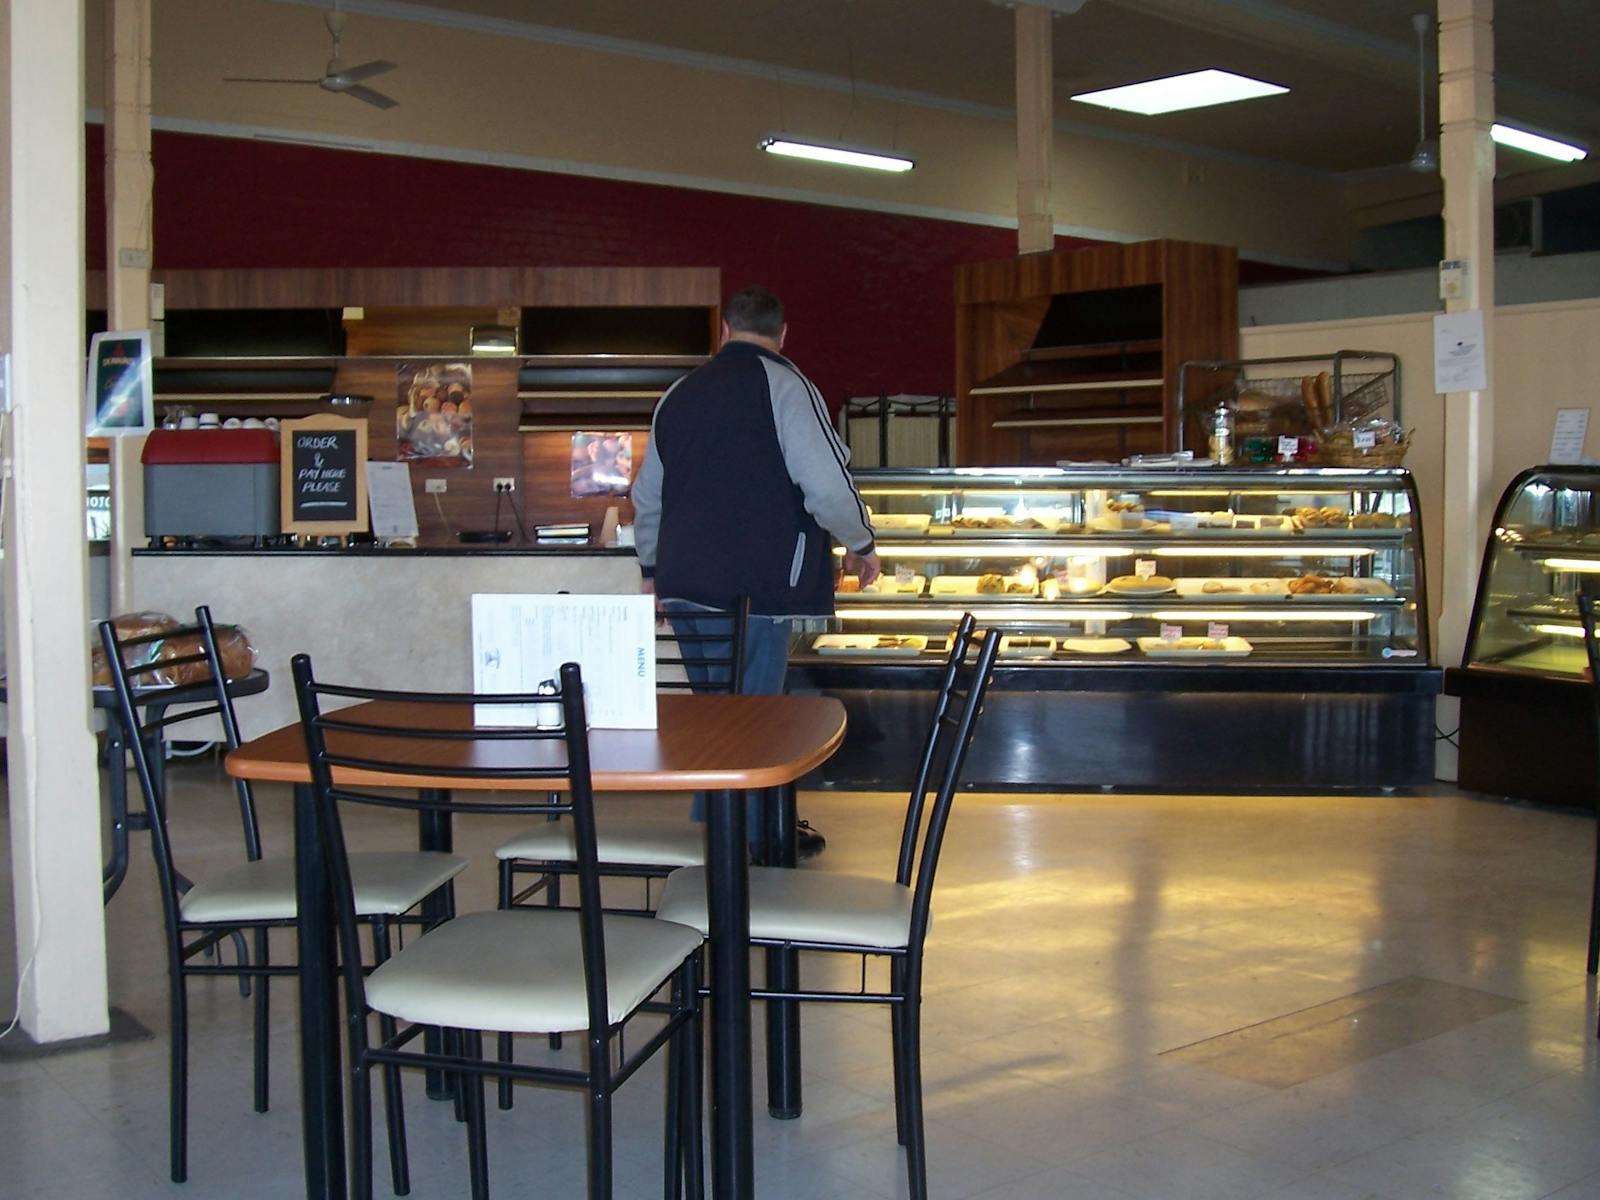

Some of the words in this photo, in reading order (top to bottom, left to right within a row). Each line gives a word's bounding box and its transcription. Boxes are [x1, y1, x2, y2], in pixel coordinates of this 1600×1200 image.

[298, 436, 338, 449] ORDER
[314, 452, 324, 468] &
[298, 468, 320, 480] PAY
[321, 468, 346, 478] HERE
[302, 481, 341, 493] PLEASE
[637, 647, 646, 678] MENU
